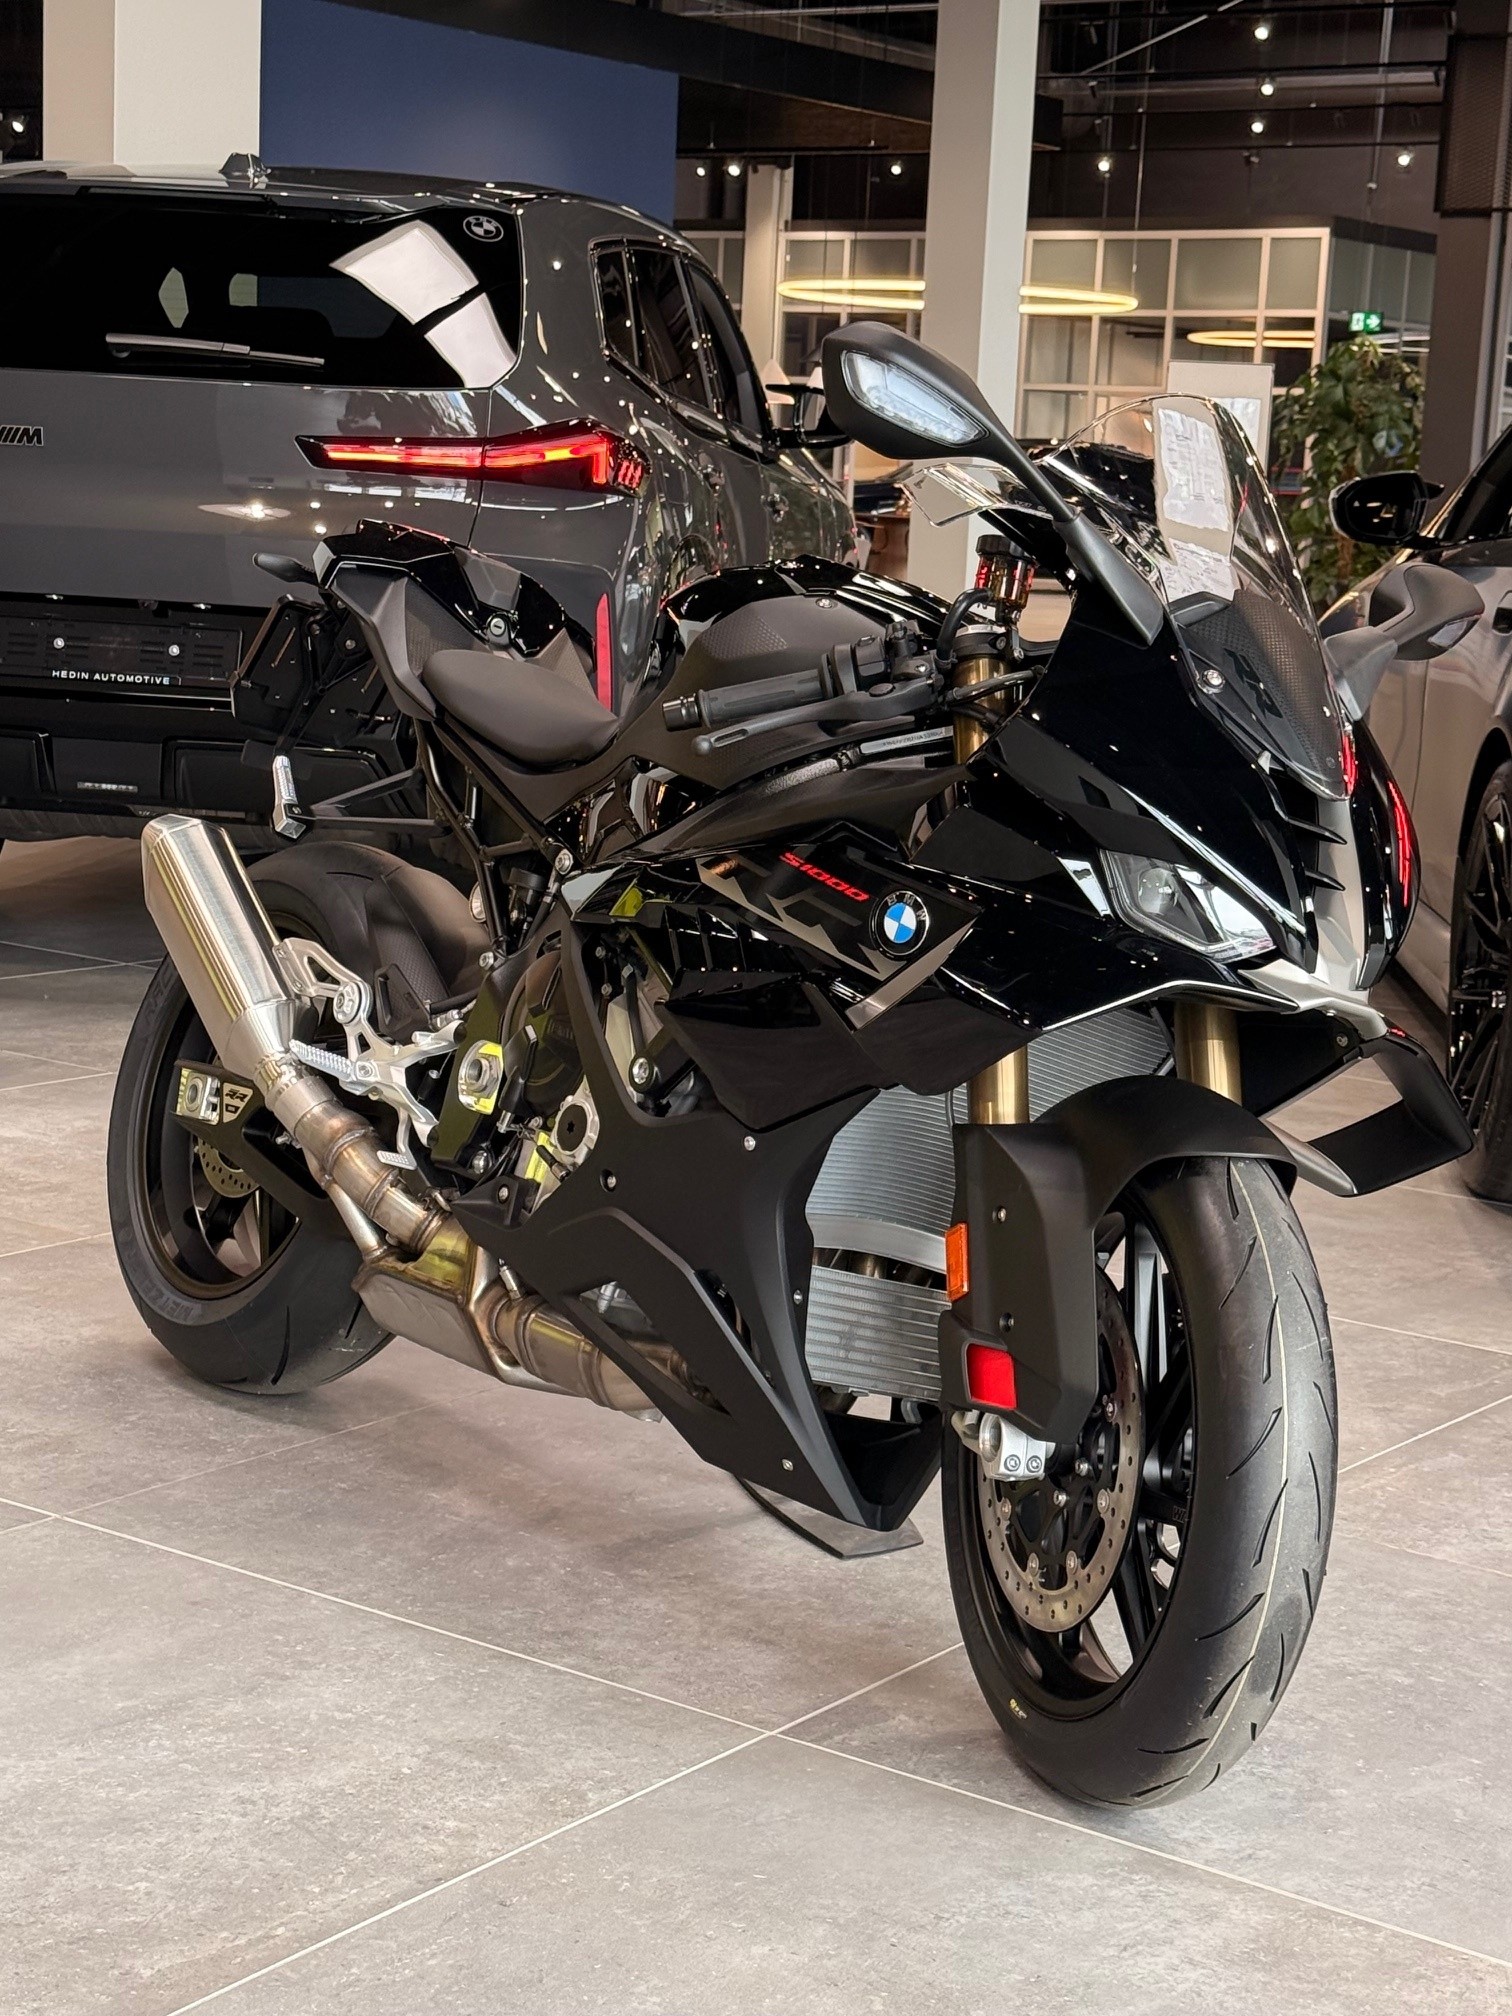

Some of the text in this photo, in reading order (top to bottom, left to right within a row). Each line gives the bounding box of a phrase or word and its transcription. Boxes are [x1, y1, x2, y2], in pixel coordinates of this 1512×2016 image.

[52, 669, 170, 685] HEDIN AUTOMOTIVE
[779, 852, 870, 903] S1000
[887, 892, 928, 921] BMW
